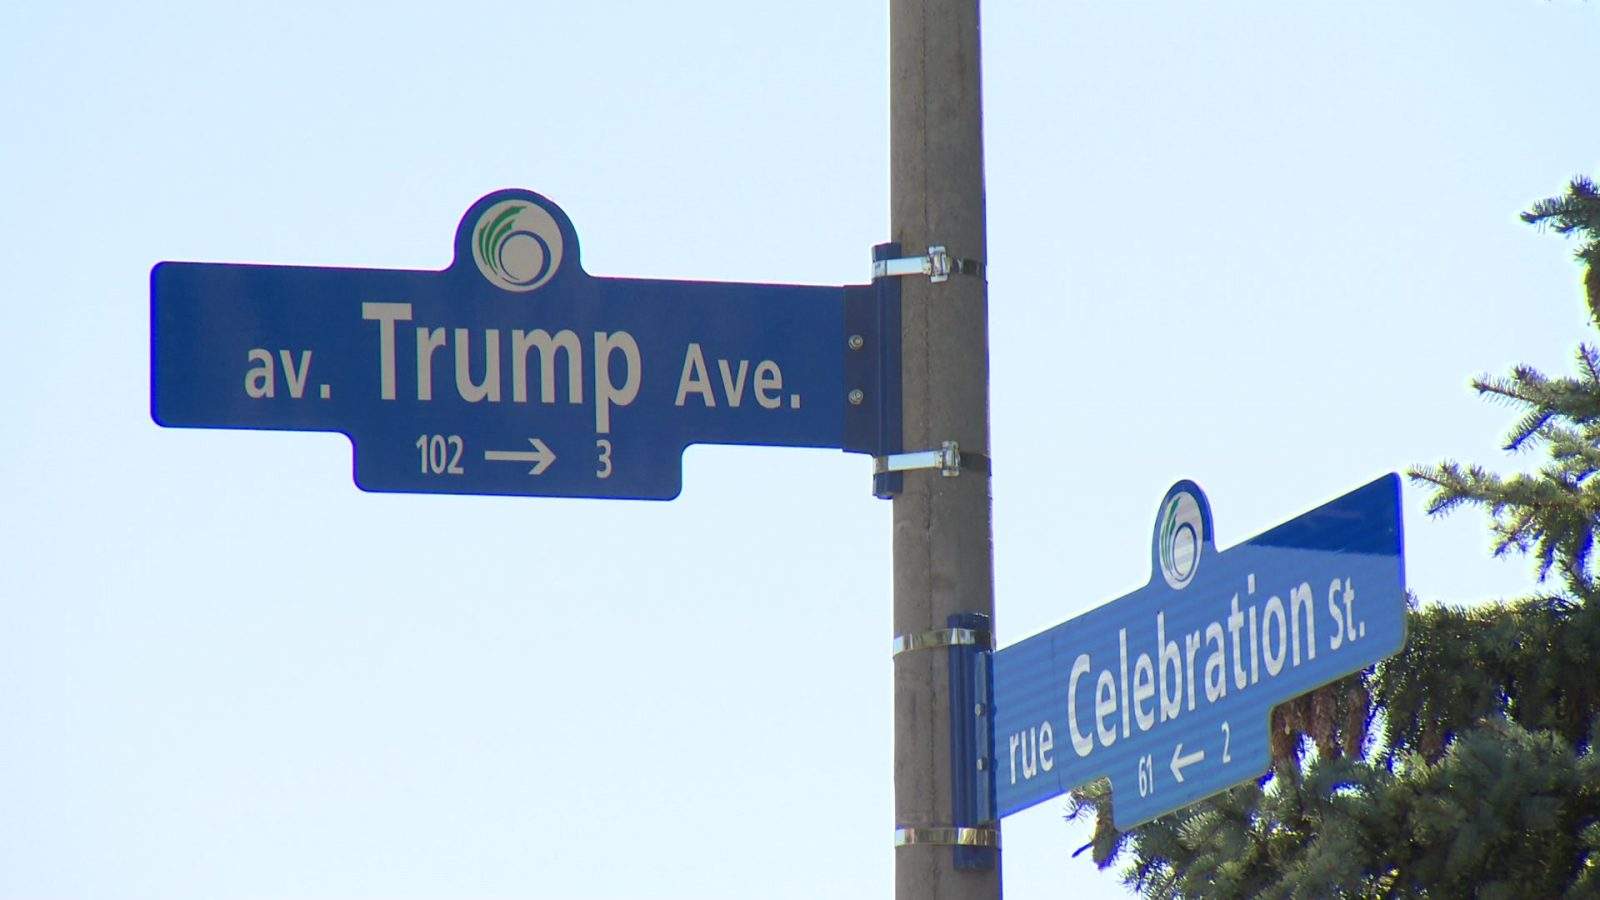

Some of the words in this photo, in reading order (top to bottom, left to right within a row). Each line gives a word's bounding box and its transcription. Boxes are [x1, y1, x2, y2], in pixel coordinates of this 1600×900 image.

[245, 348, 332, 400] av.
[362, 301, 642, 434] Trump
[675, 342, 802, 410] Ave.
[415, 434, 464, 475] 102
[596, 439, 612, 479] 3
[1009, 721, 1054, 785] rue
[1068, 573, 1316, 757] Celebration
[1328, 575, 1367, 651] St.
[1138, 754, 1153, 798] 61
[1221, 721, 1231, 764] 2
